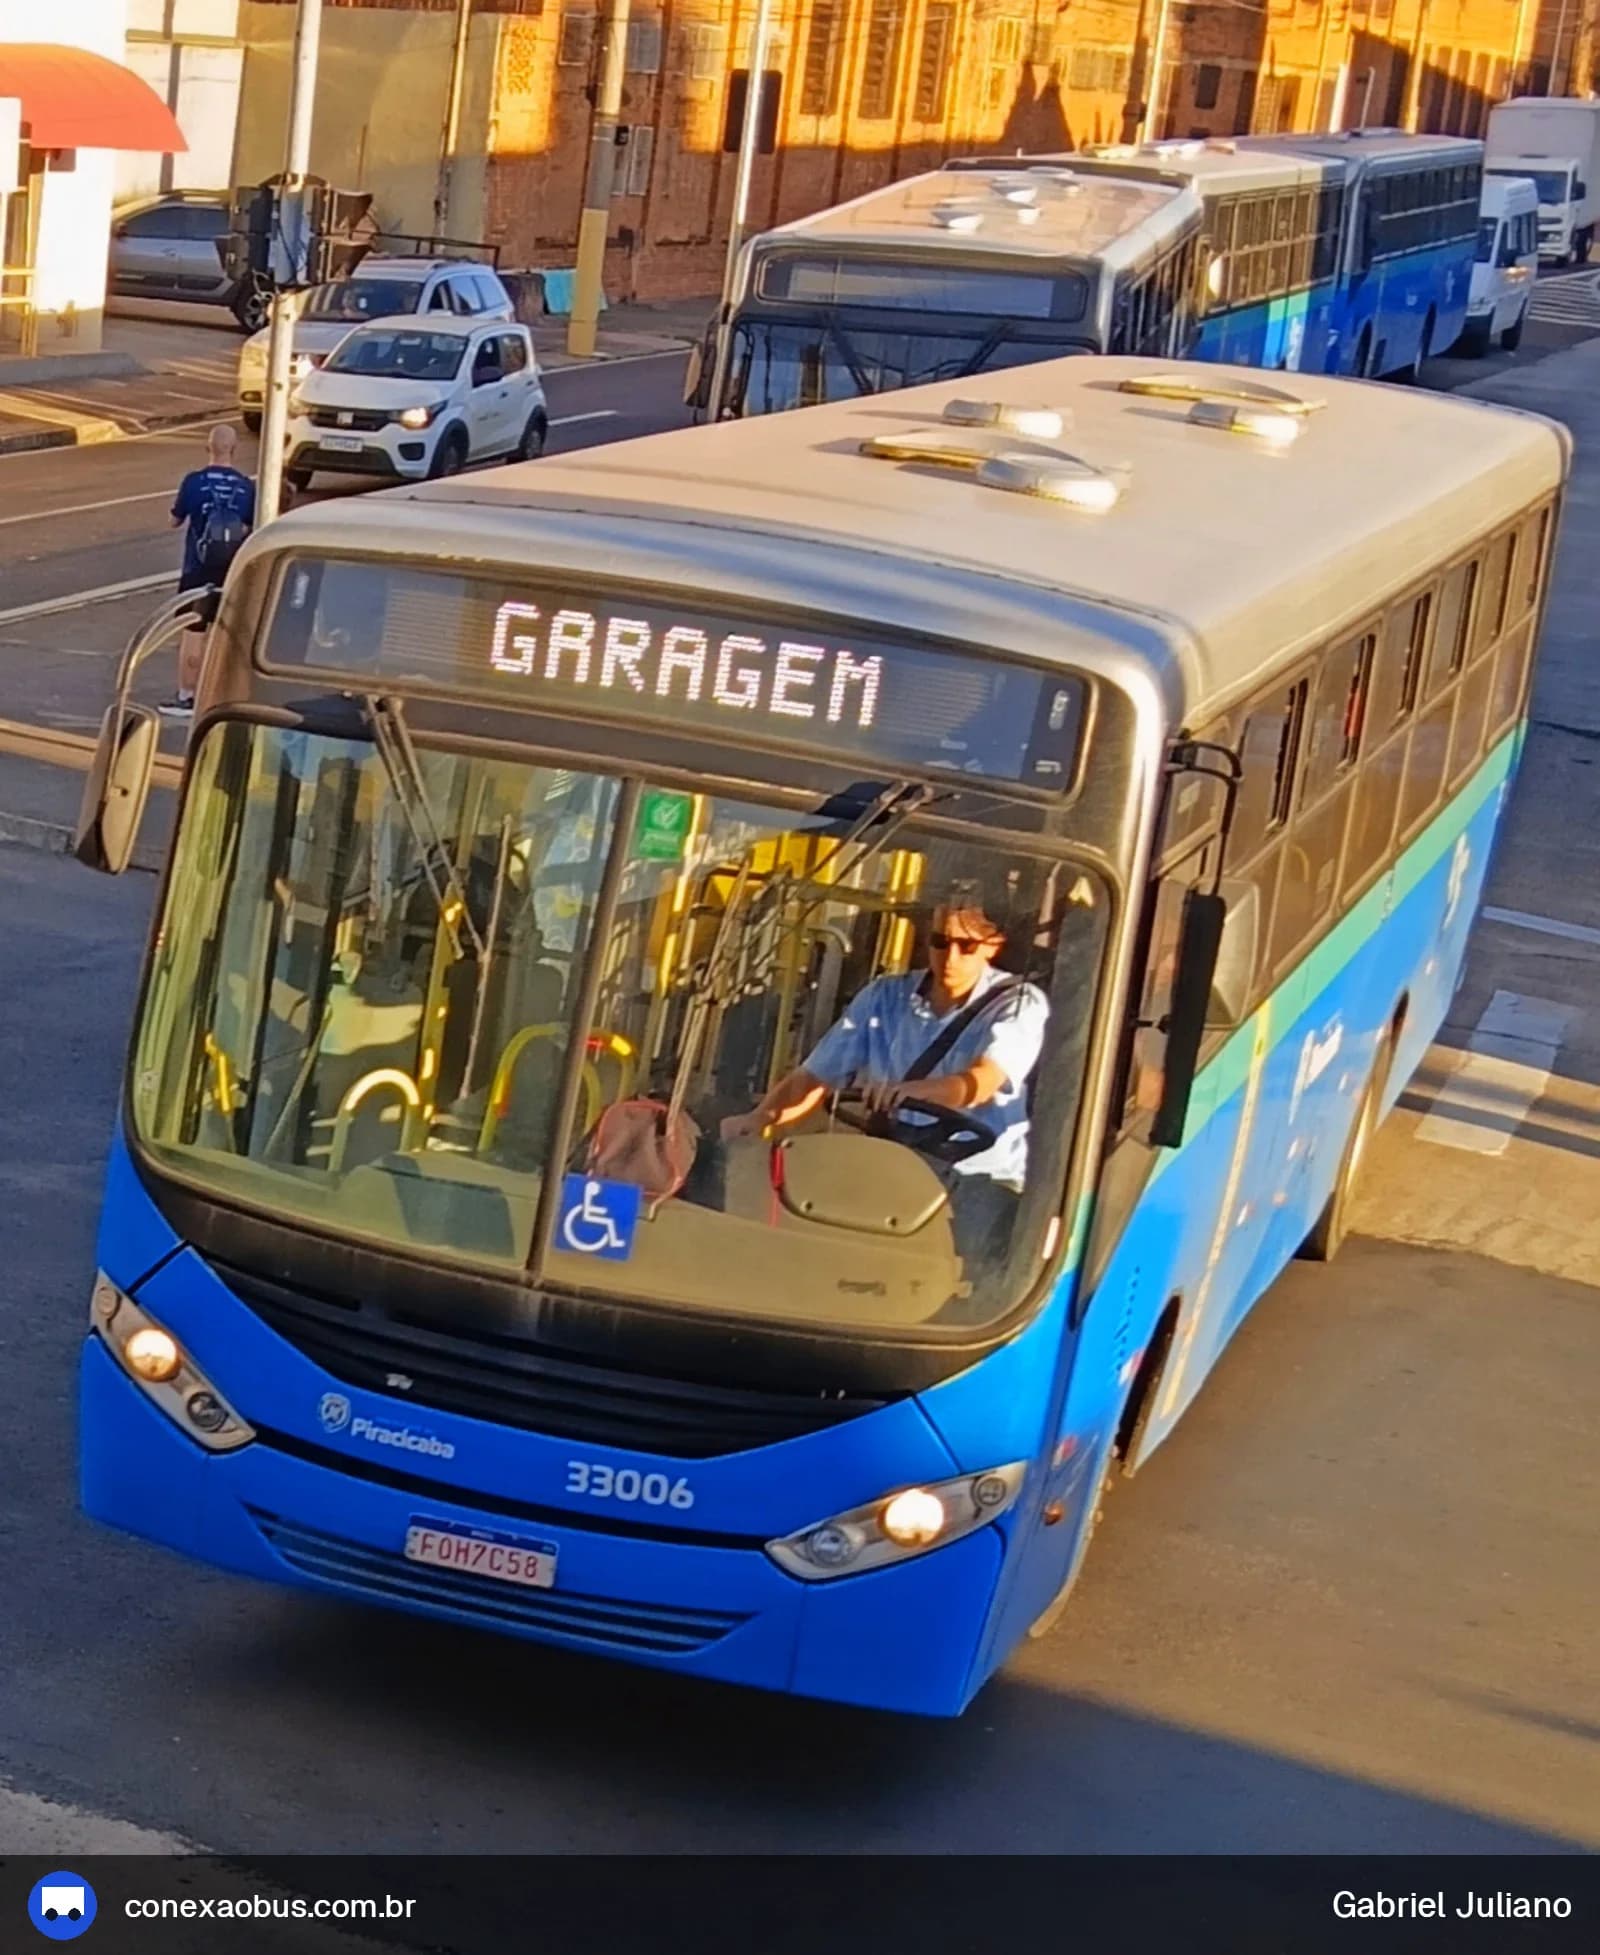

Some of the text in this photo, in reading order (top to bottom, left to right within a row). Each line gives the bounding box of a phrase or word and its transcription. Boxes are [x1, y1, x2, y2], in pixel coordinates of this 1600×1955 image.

[490, 601, 883, 727] GARAGEM
[351, 1417, 455, 1459] Piracicaba
[565, 1461, 694, 1509] 33006
[420, 1533, 539, 1578] FOH7C58
